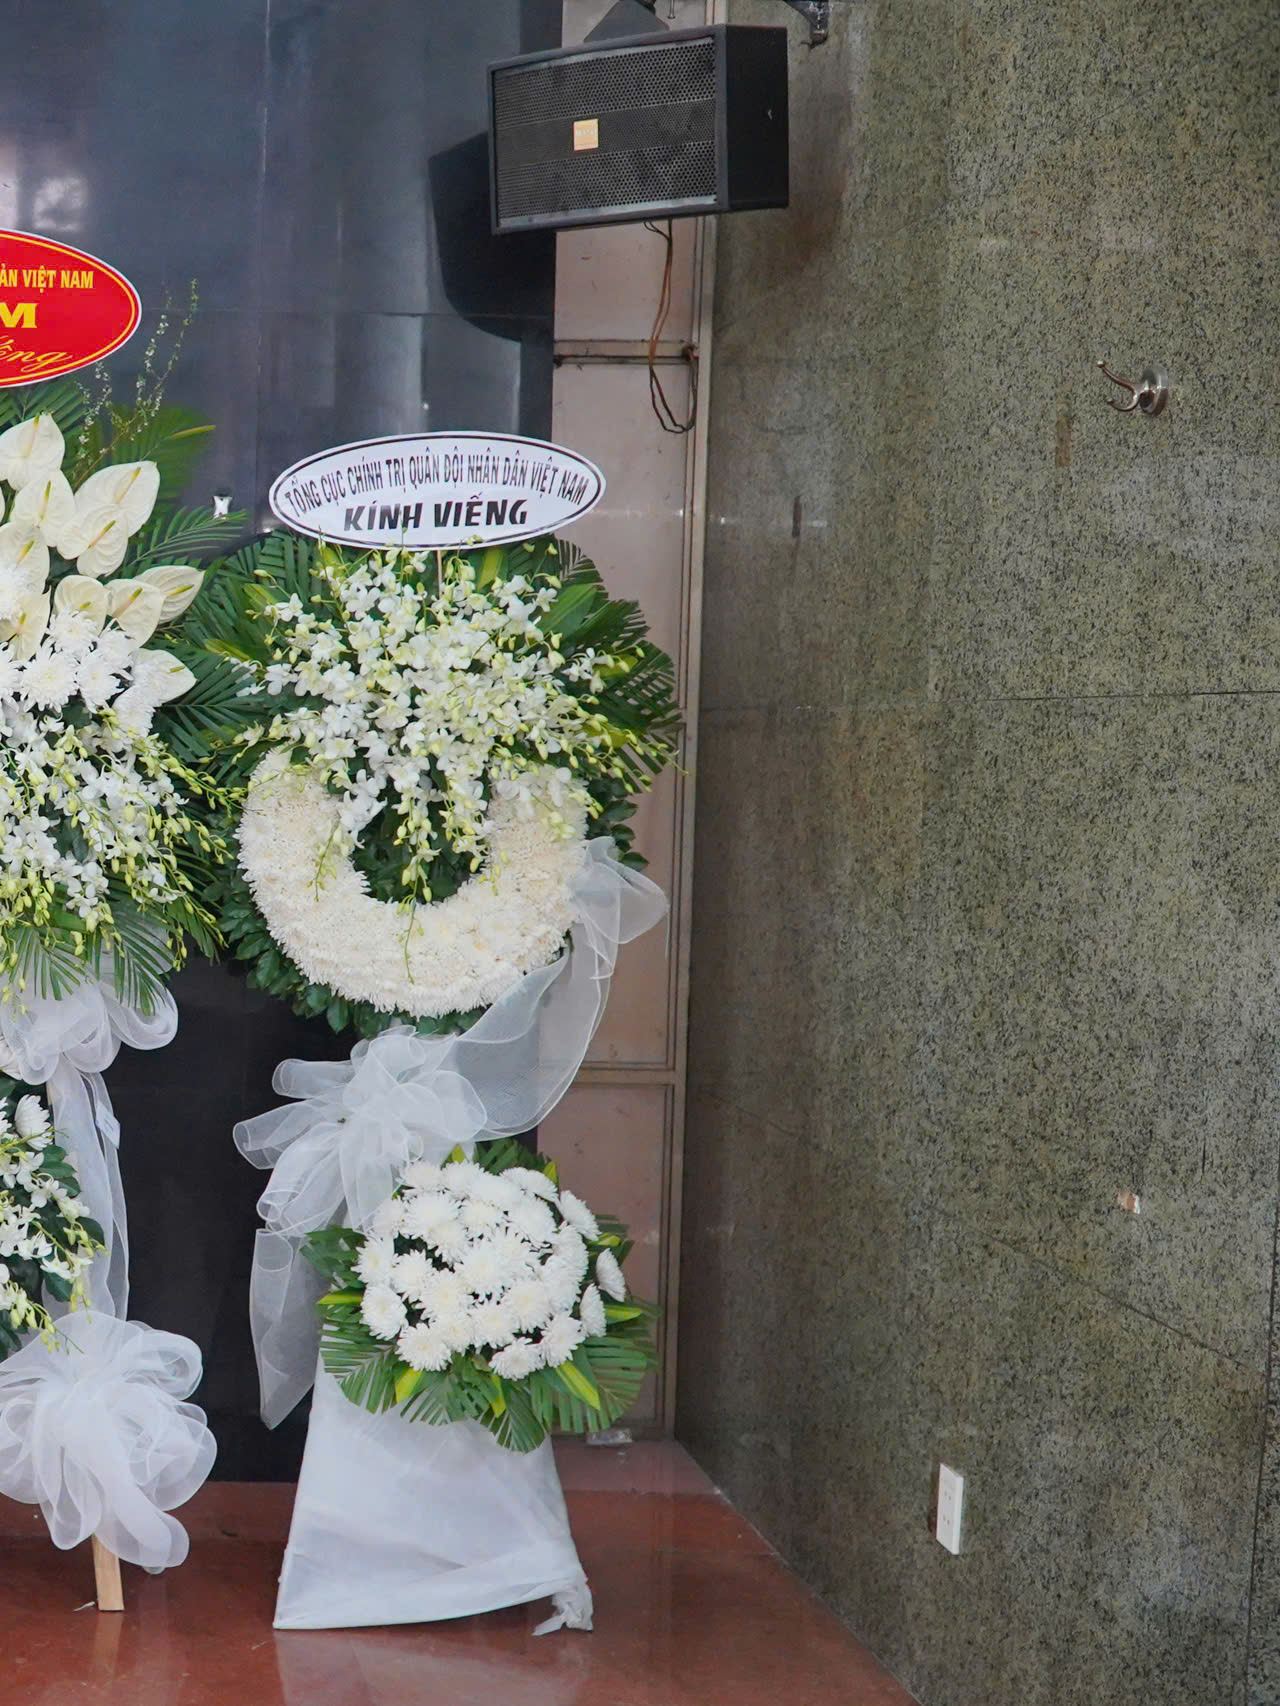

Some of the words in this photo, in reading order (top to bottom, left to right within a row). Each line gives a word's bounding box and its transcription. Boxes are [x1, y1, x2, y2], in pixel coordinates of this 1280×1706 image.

[22, 265, 57, 294] VIỆT
[60, 271, 94, 288] NAM
[321, 470, 346, 507] CỤC
[347, 456, 384, 496] CHÍNH
[386, 457, 406, 493] TRỊ
[409, 446, 440, 489] QUÂN
[444, 446, 464, 488] ĐỘI
[467, 447, 500, 484] NHÂN
[502, 450, 529, 487] DÂN
[530, 456, 559, 498] VIỆT
[557, 469, 590, 506] NAM
[344, 500, 423, 531] KÍNH
[434, 491, 528, 528] VIẾNG
